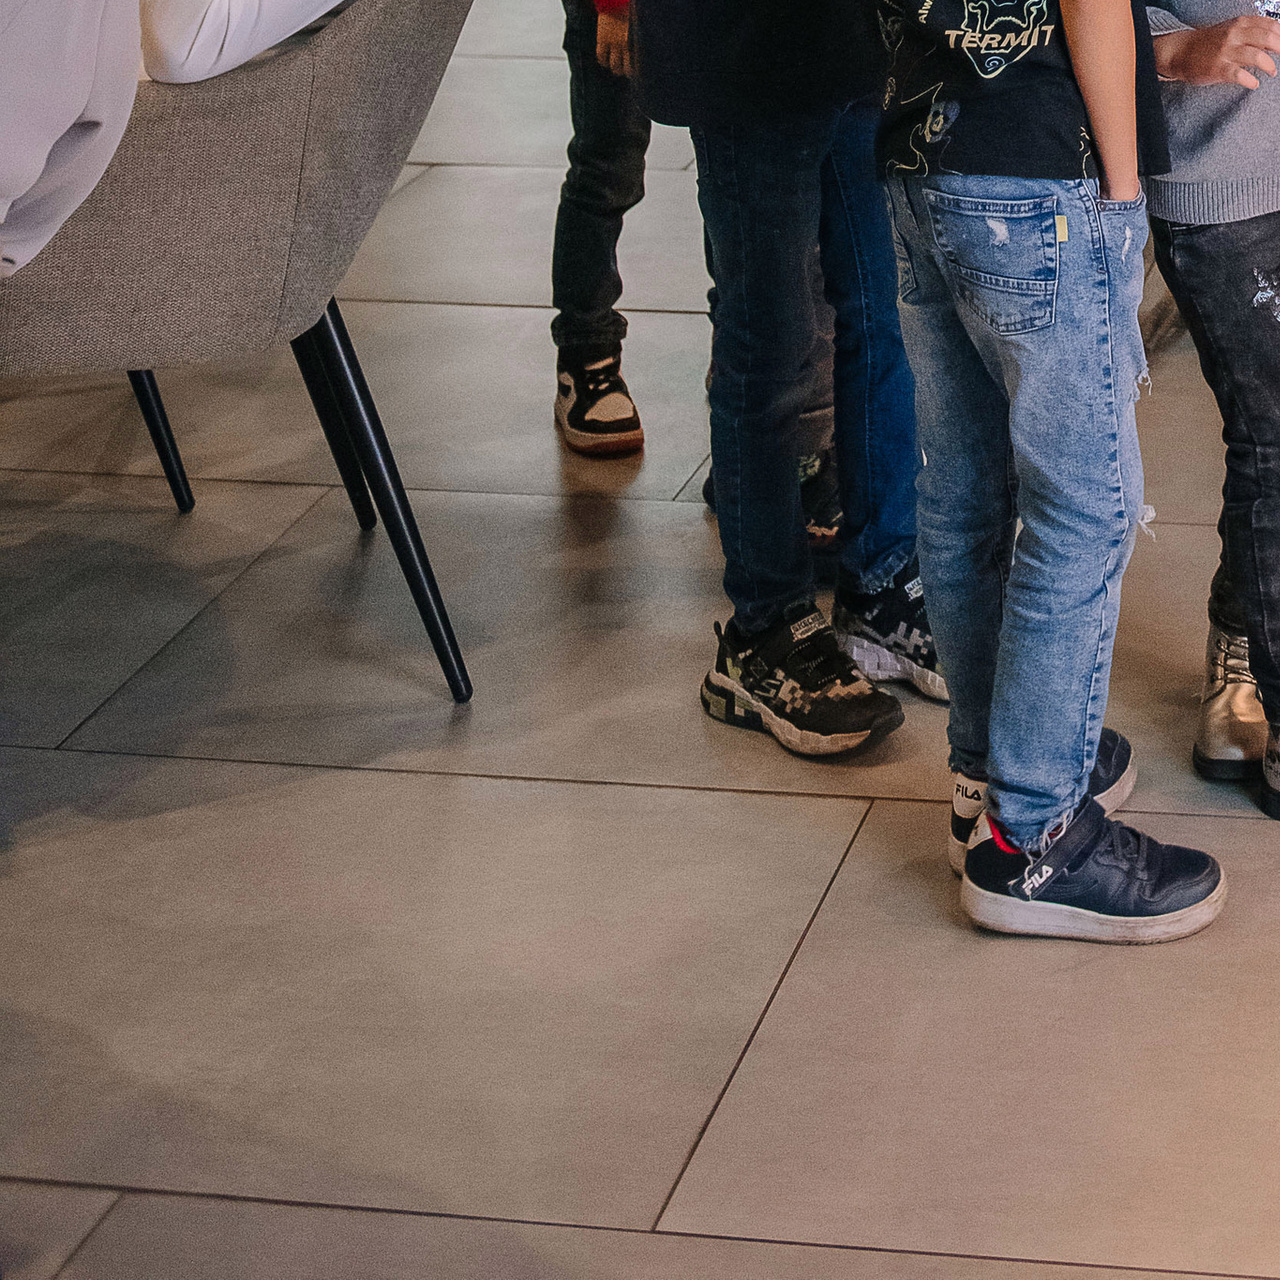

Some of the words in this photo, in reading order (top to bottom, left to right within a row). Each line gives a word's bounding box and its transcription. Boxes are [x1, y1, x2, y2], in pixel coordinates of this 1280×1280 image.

[944, 24, 1055, 49] TERMIT
[955, 783, 982, 801] FILA
[1021, 864, 1054, 896] FILA
